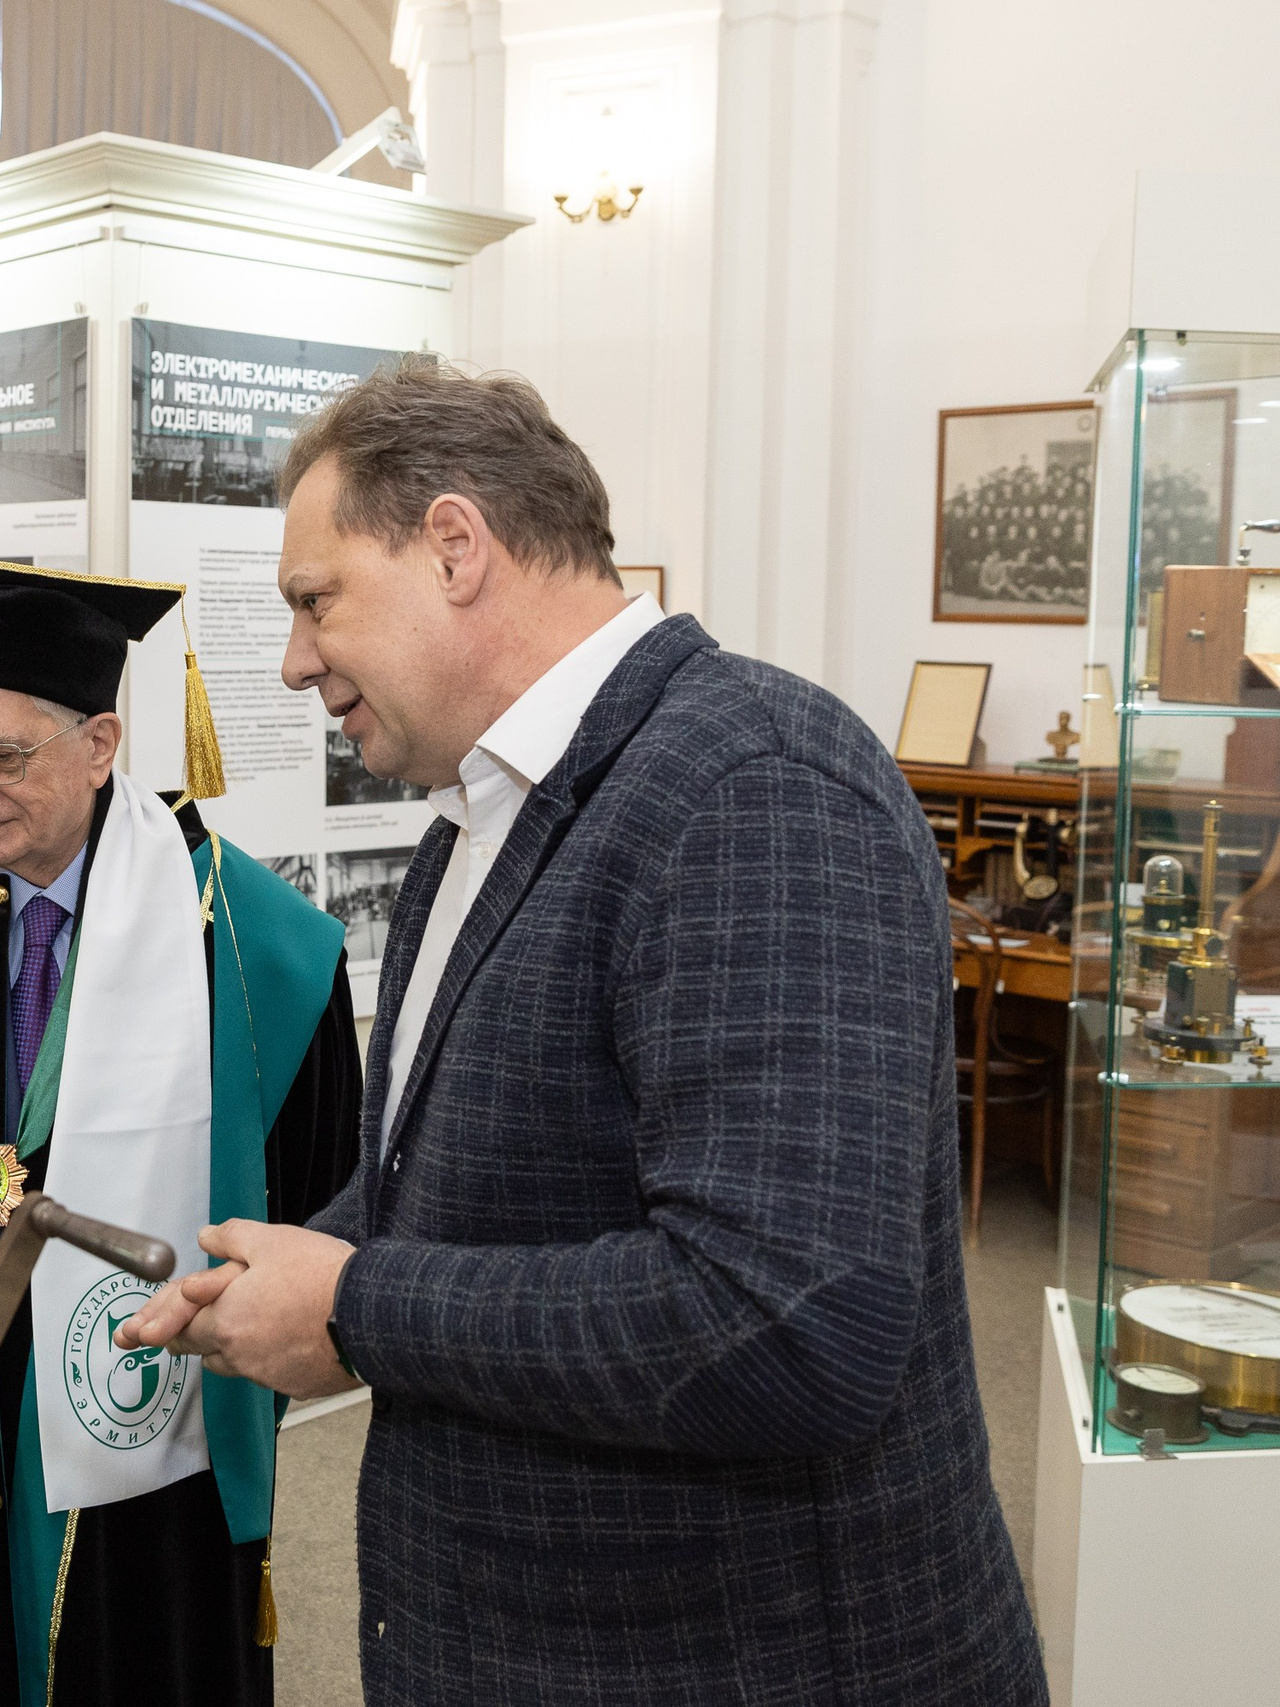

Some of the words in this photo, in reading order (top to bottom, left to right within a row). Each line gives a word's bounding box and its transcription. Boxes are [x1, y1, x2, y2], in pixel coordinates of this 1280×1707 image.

[151, 378, 164, 400] И
[151, 405, 253, 436] ОТДЕЛЕНИЯ
[71, 1275, 168, 1353] ГОСУДАРСТВЕ
[76, 1381, 182, 1445] ЭРМИТАЖ
